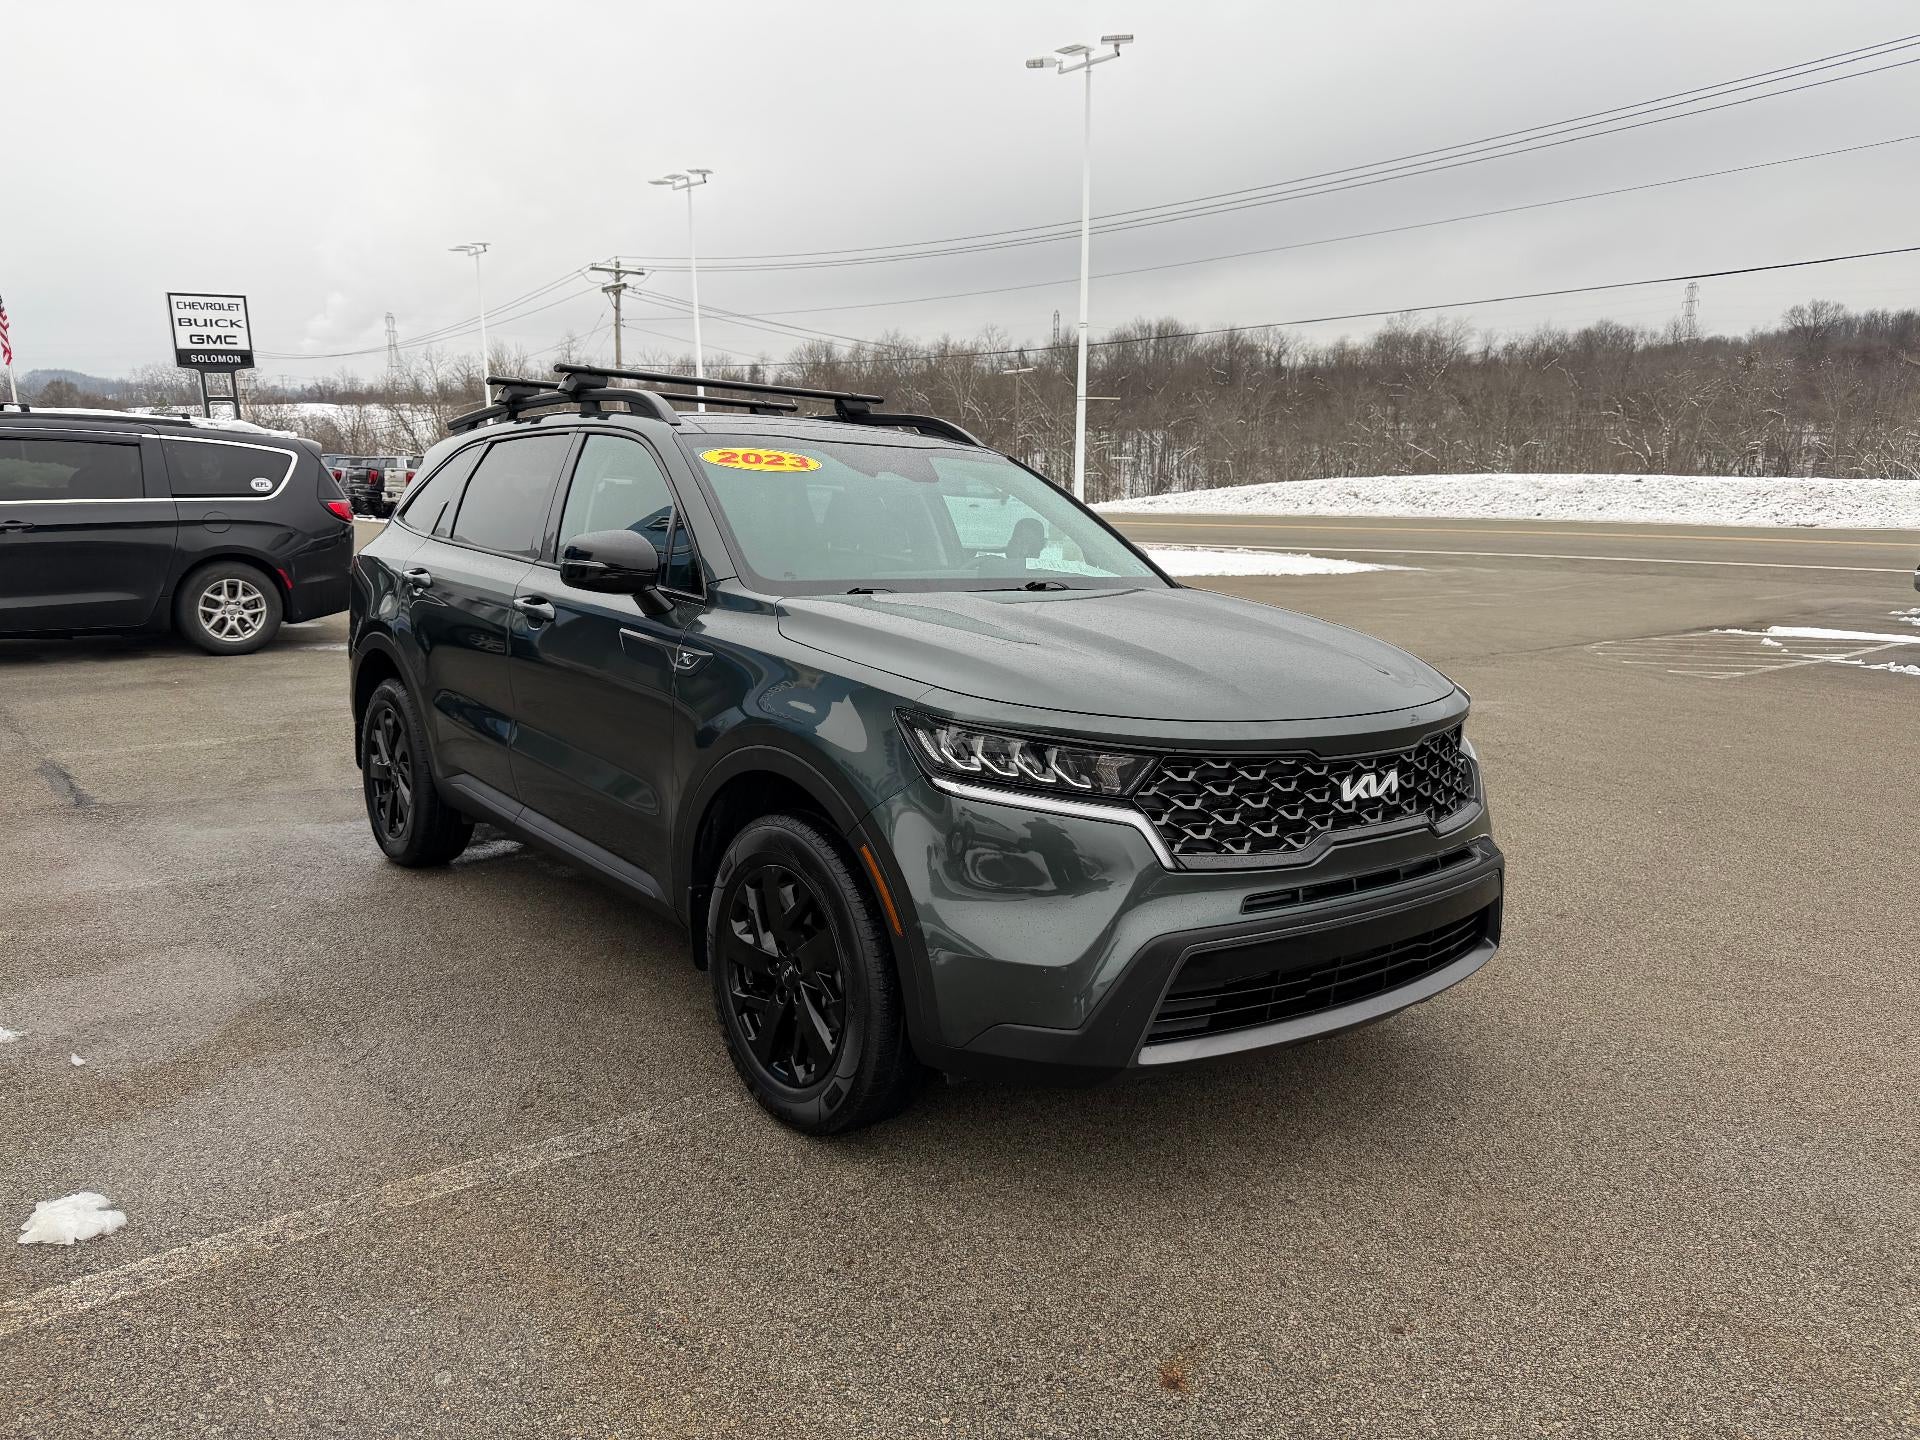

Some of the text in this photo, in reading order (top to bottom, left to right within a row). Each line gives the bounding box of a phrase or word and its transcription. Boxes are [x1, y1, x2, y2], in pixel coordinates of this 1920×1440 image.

[176, 301, 240, 311] CHEVROLET
[177, 317, 244, 328] BUICK
[189, 334, 238, 345] GMC
[190, 354, 241, 363] SOLOMON
[717, 451, 809, 468] 2023
